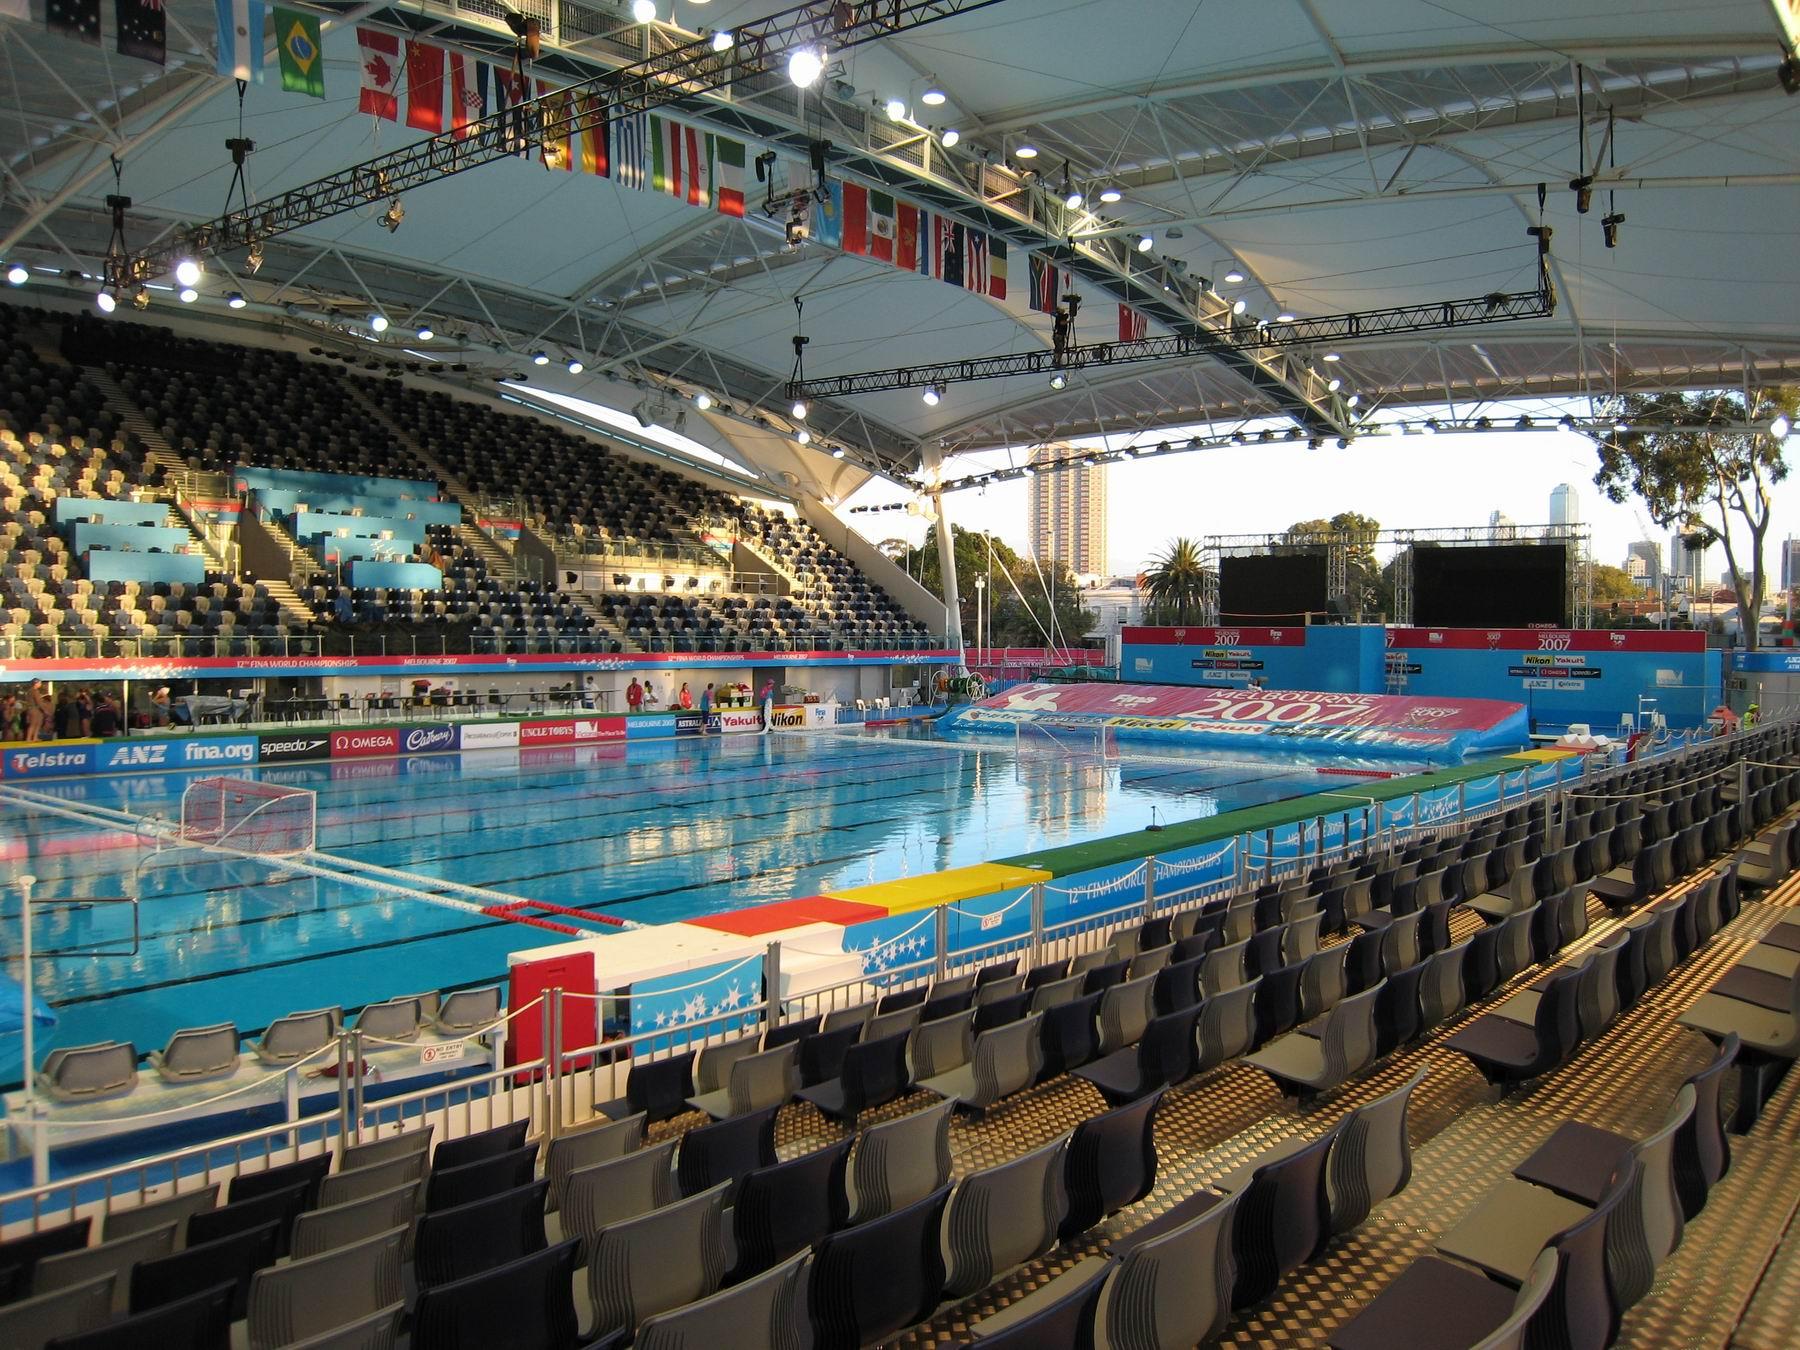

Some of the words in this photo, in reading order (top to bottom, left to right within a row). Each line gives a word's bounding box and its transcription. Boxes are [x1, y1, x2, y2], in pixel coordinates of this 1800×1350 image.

[1214, 635, 1240, 646] 2007
[1538, 639, 1571, 651] 2007
[1204, 650, 1225, 658] Nikon
[1525, 655, 1551, 665] Nikon
[1555, 656, 1584, 664] Yakult
[269, 660, 297, 668] WORLD
[298, 659, 358, 668] CHAMPIONSHIPS
[1207, 690, 1379, 706] MELBOURNE
[1177, 698, 1371, 725] 2007
[627, 719, 662, 729] MELBOURNE
[723, 716, 762, 726] Yakult
[771, 712, 803, 727] Nikon
[521, 728, 549, 738] UNCLE
[549, 726, 574, 736] TOBYS
[351, 736, 394, 749] OMEGA
[406, 727, 455, 751] Cadbury
[185, 743, 253, 760] fina.org
[260, 739, 307, 755] speedo
[16, 753, 86, 768] Telstra
[109, 745, 168, 766] ANZ
[1086, 879, 1112, 901] FINA
[1112, 866, 1148, 893] WORLD
[1153, 851, 1222, 883] CHAMPIONSHIPS
